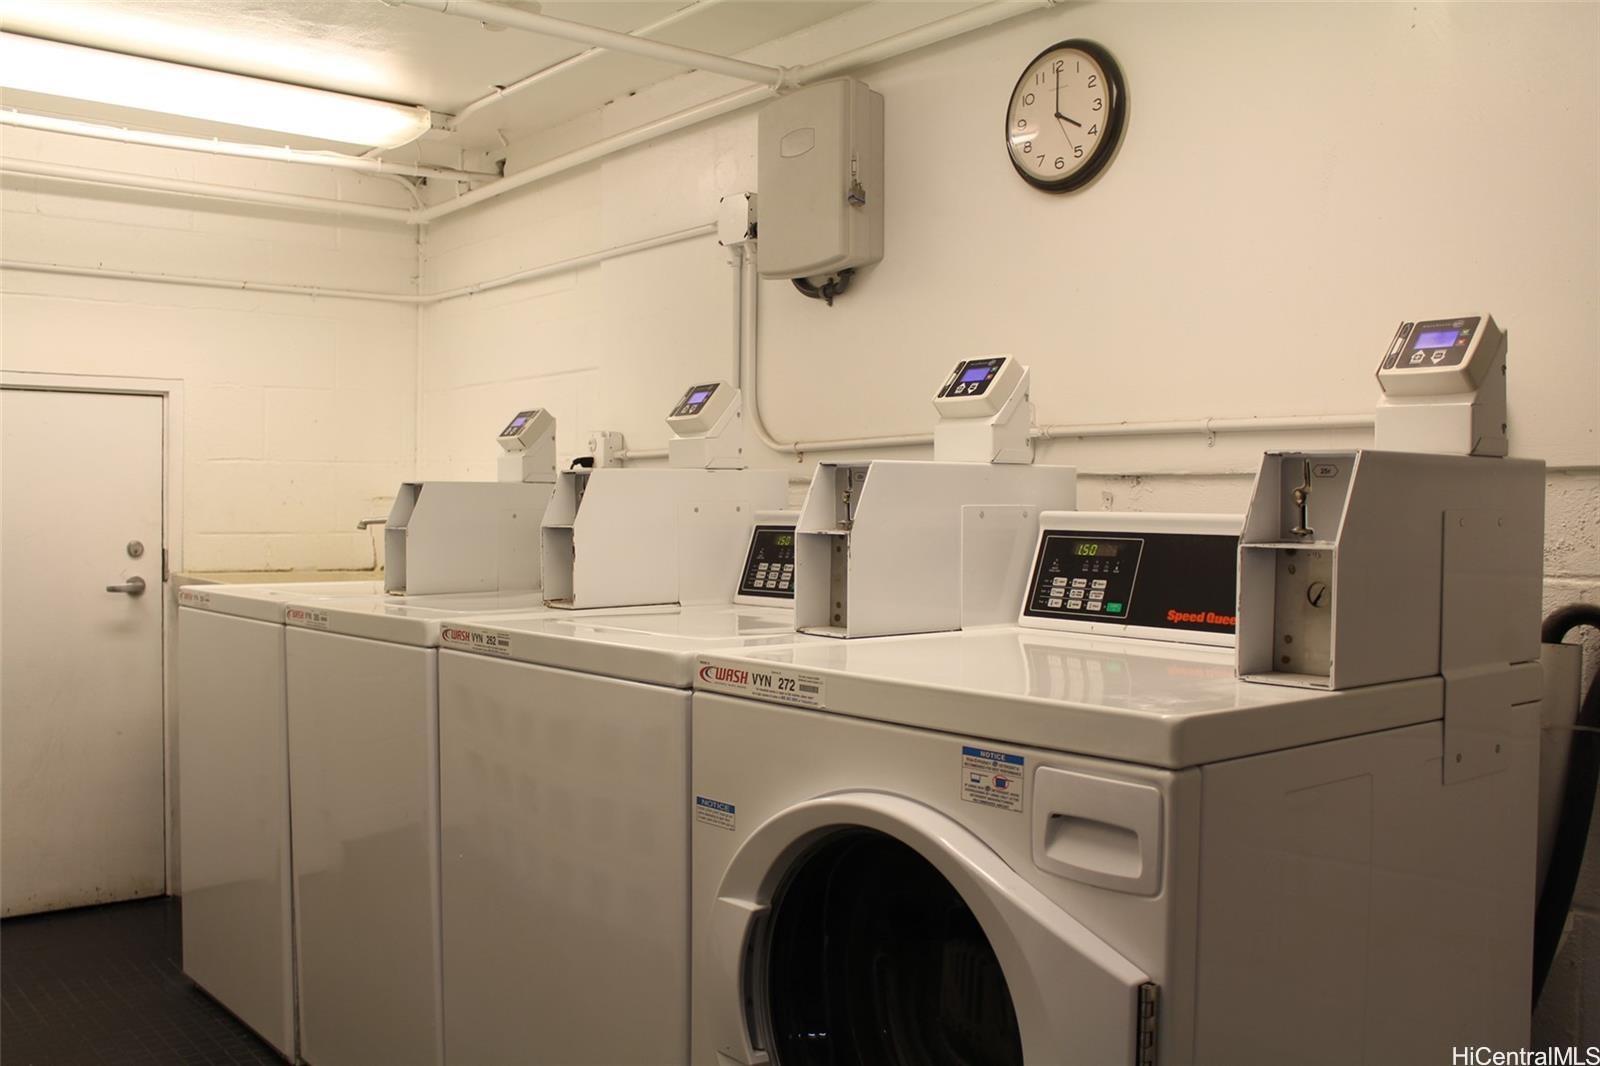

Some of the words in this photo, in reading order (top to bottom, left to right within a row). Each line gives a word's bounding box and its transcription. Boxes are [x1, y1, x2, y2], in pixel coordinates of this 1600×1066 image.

[1052, 60, 1065, 74] 12
[1076, 61, 1080, 73] 1
[1035, 72, 1045, 85] 11
[1087, 75, 1097, 88] 2
[1022, 93, 1035, 107] 10
[1092, 98, 1103, 111] 3
[1017, 119, 1027, 131] 9
[1087, 124, 1098, 136] 4
[1023, 141, 1033, 154] 8
[1073, 145, 1084, 158] 5
[1036, 154, 1046, 167] 7
[1054, 156, 1065, 170] 6
[1167, 609, 1206, 624] Speed
[1206, 612, 1239, 626] Quee
[451, 629, 470, 641] WASH
[715, 667, 749, 685] WASH
[752, 673, 772, 688] VYN
[778, 678, 796, 691] 272
[980, 751, 1006, 760] NOTICE
